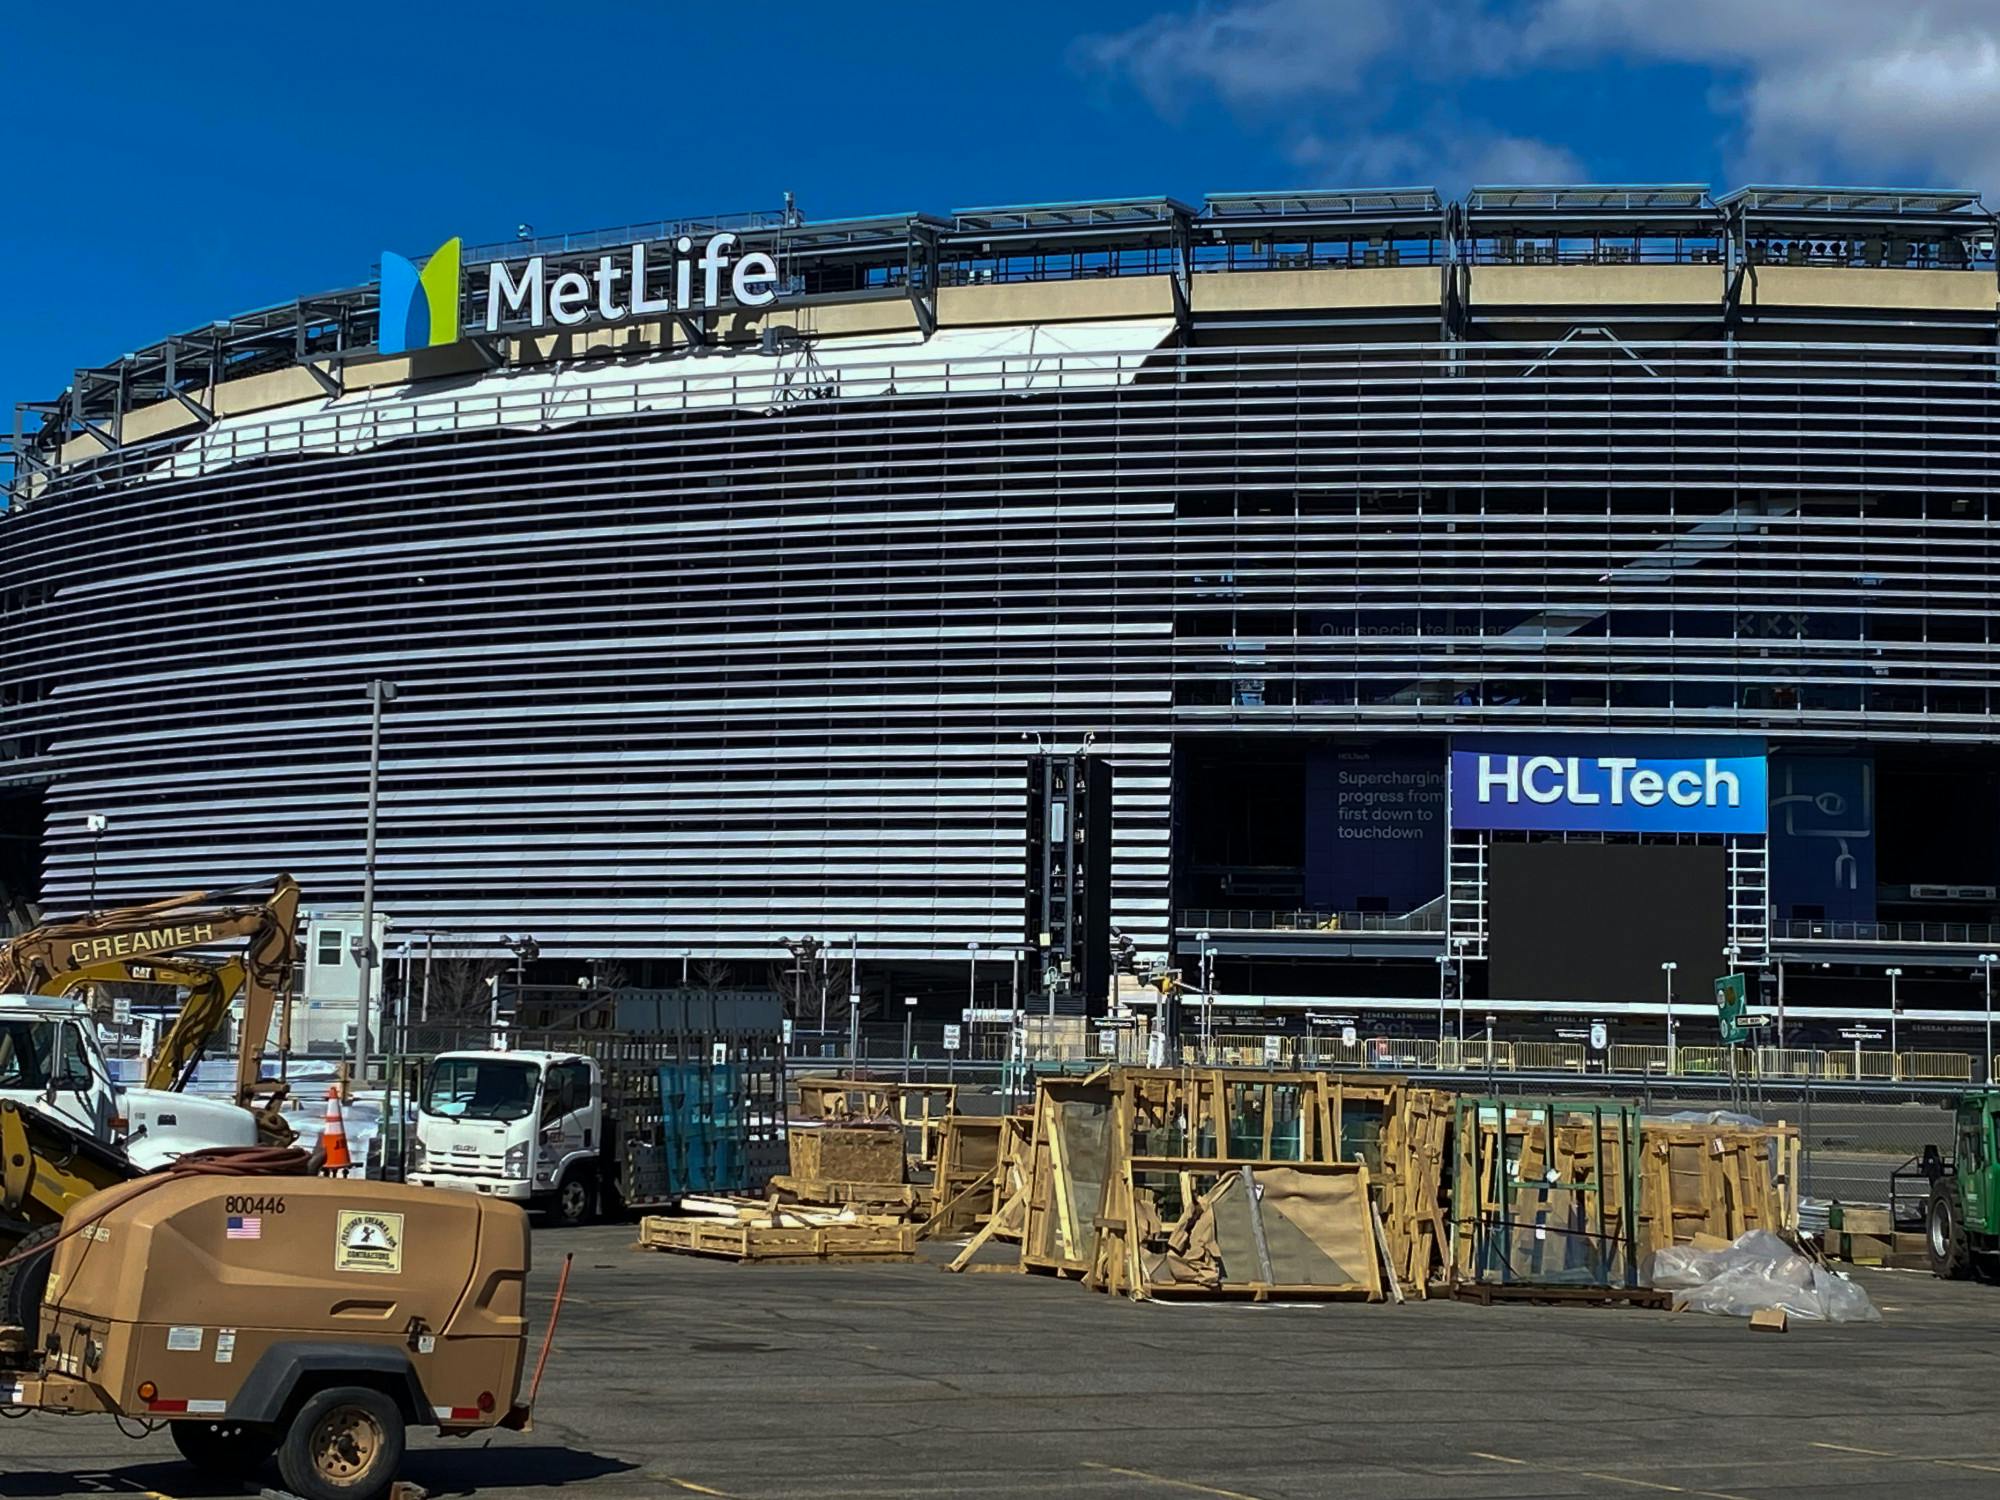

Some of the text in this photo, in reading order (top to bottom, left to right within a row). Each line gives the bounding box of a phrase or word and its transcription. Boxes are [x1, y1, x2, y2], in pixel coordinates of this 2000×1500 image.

[486, 233, 777, 332] MetLife
[1478, 755, 1740, 806] HCLTech
[1338, 789, 1444, 806] progress from
[1338, 806, 1433, 821] first down to
[1337, 824, 1423, 839] touchdown
[71, 924, 213, 962] CREAMER
[132, 966, 152, 979] CAT
[225, 1195, 286, 1214] 800446
